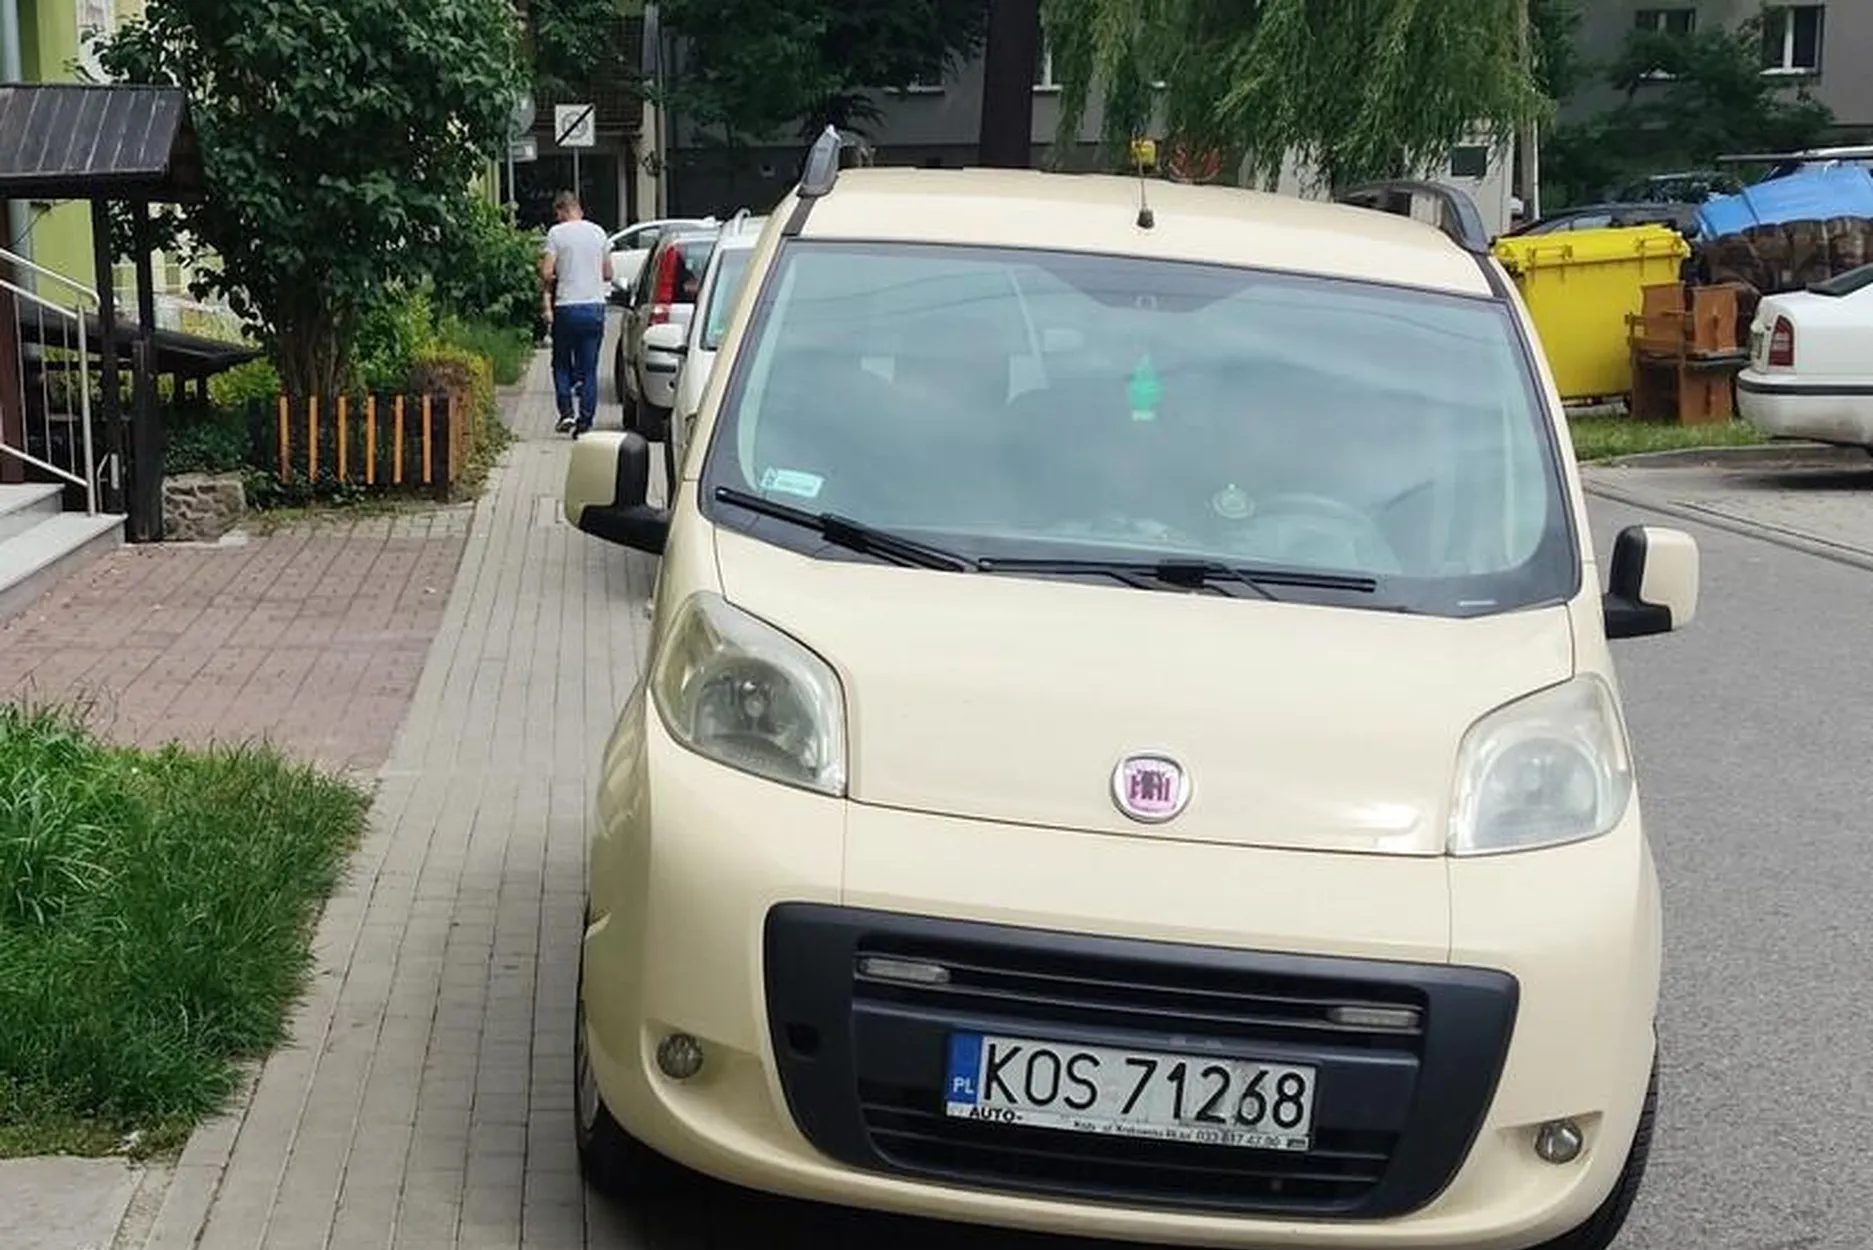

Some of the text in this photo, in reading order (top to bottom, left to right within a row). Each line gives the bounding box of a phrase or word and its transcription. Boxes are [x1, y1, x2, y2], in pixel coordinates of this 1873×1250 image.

[953, 1078, 975, 1095] PL
[983, 1043, 1306, 1129] KOS 71268
